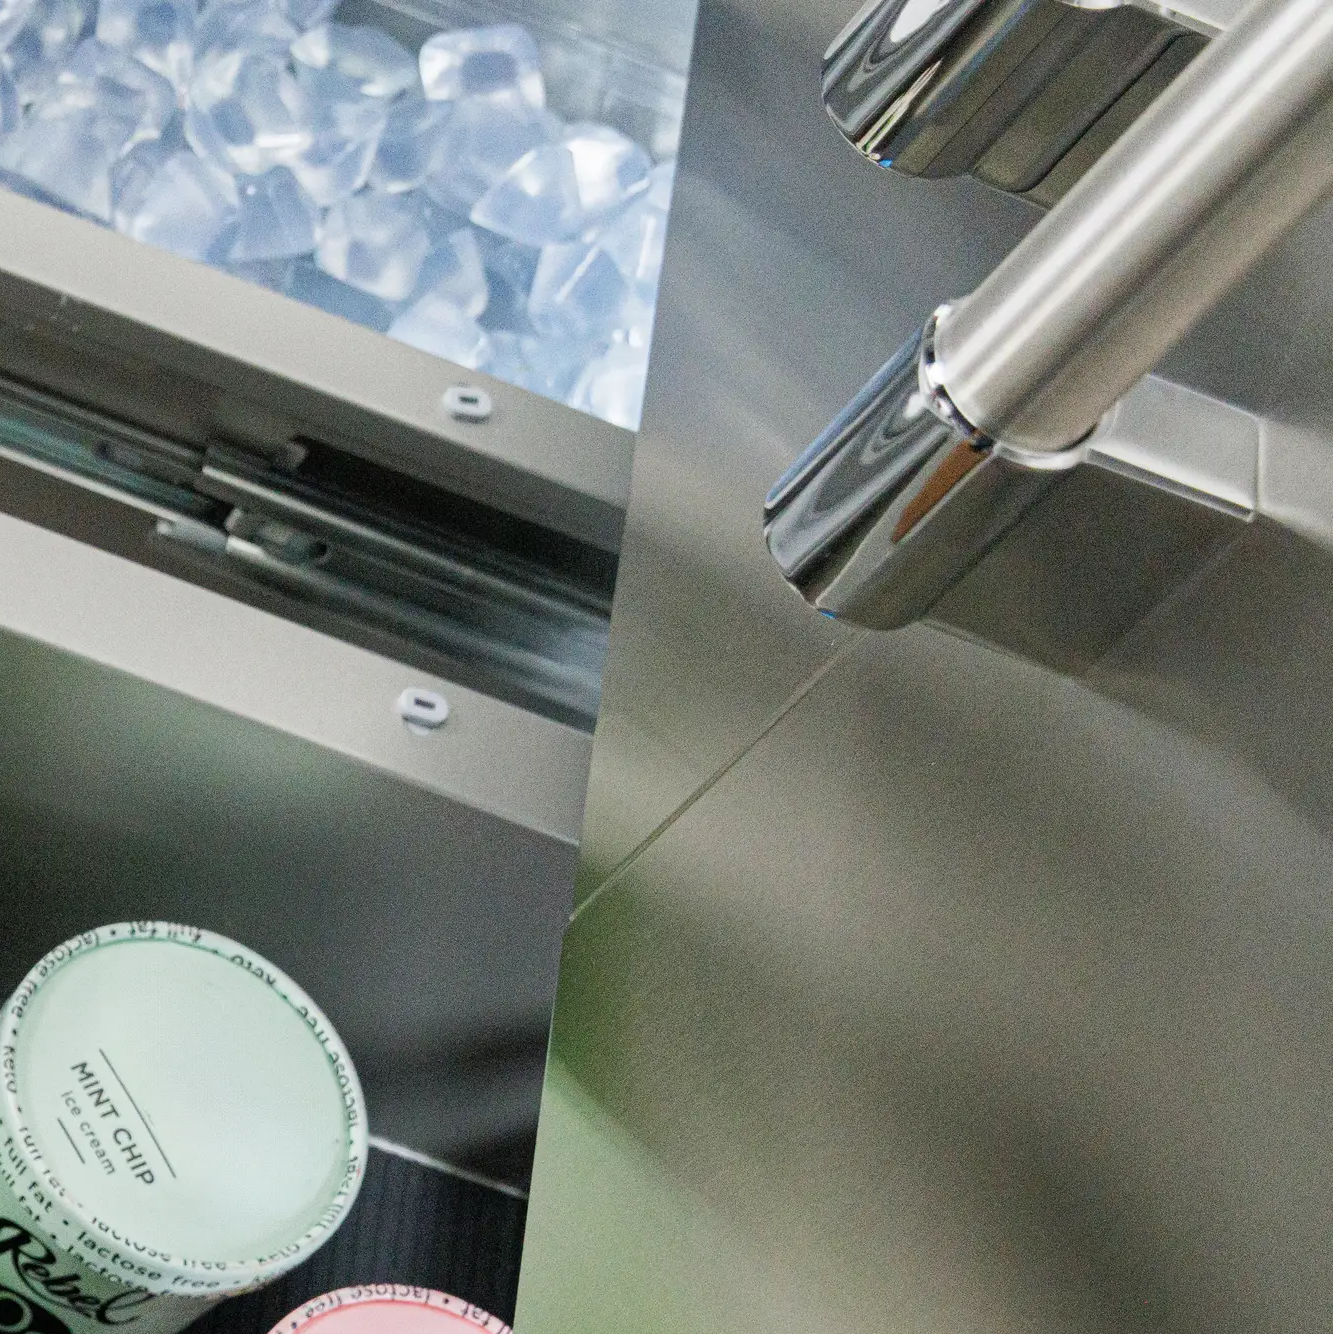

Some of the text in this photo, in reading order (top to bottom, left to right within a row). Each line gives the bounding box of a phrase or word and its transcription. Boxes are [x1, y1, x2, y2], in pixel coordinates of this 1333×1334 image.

[60, 1090, 116, 1176] ice cream
[69, 1061, 155, 1188] MINT CHIP
[4, 1136, 221, 1290] full fat lactose free
